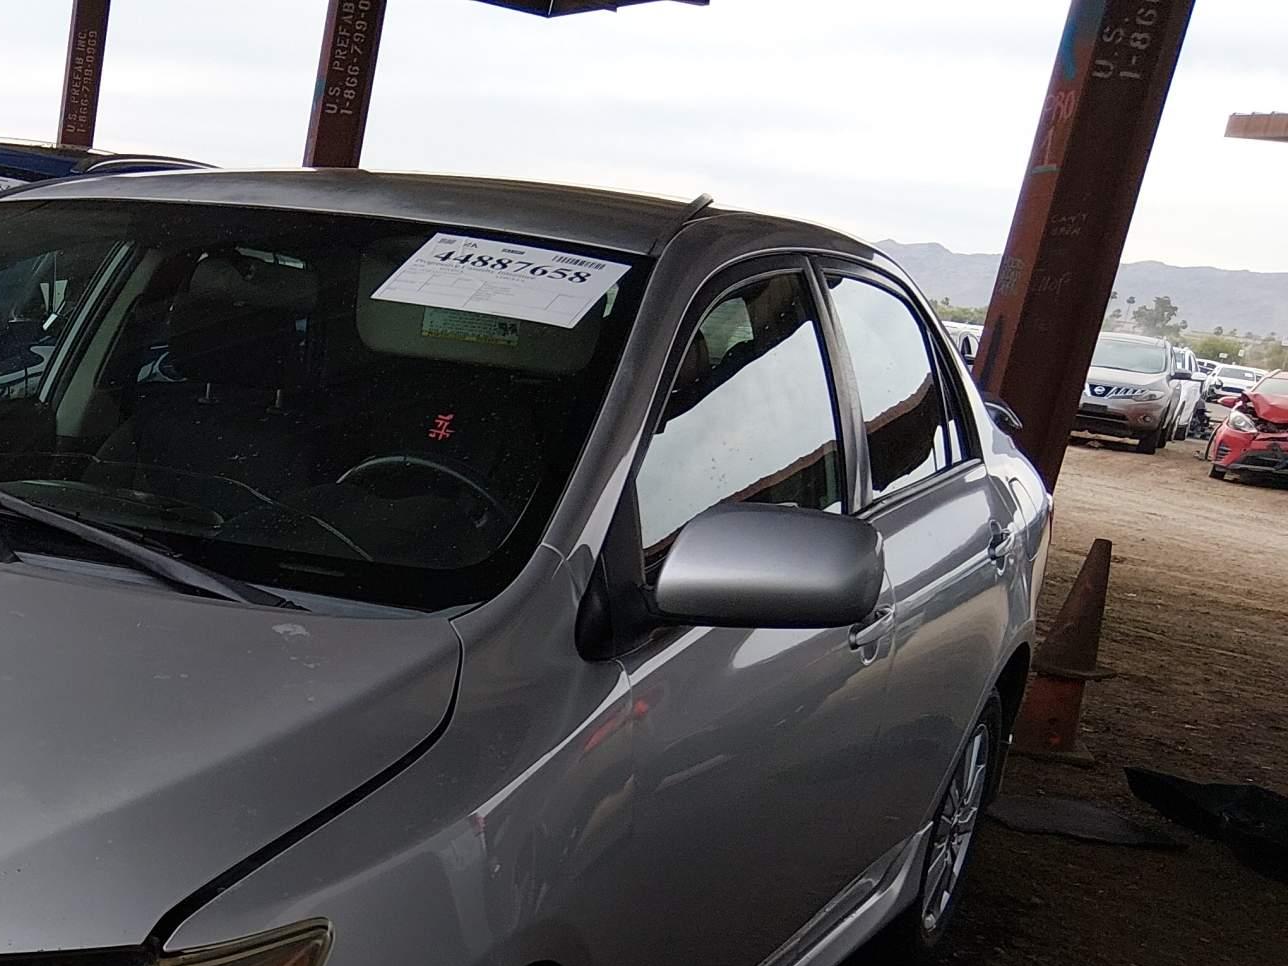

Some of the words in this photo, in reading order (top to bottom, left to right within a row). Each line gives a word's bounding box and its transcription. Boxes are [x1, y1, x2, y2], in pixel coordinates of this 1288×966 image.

[332, 1, 355, 71] PREFAB
[71, 57, 84, 104] PREFAB
[434, 250, 592, 284] 44887658
